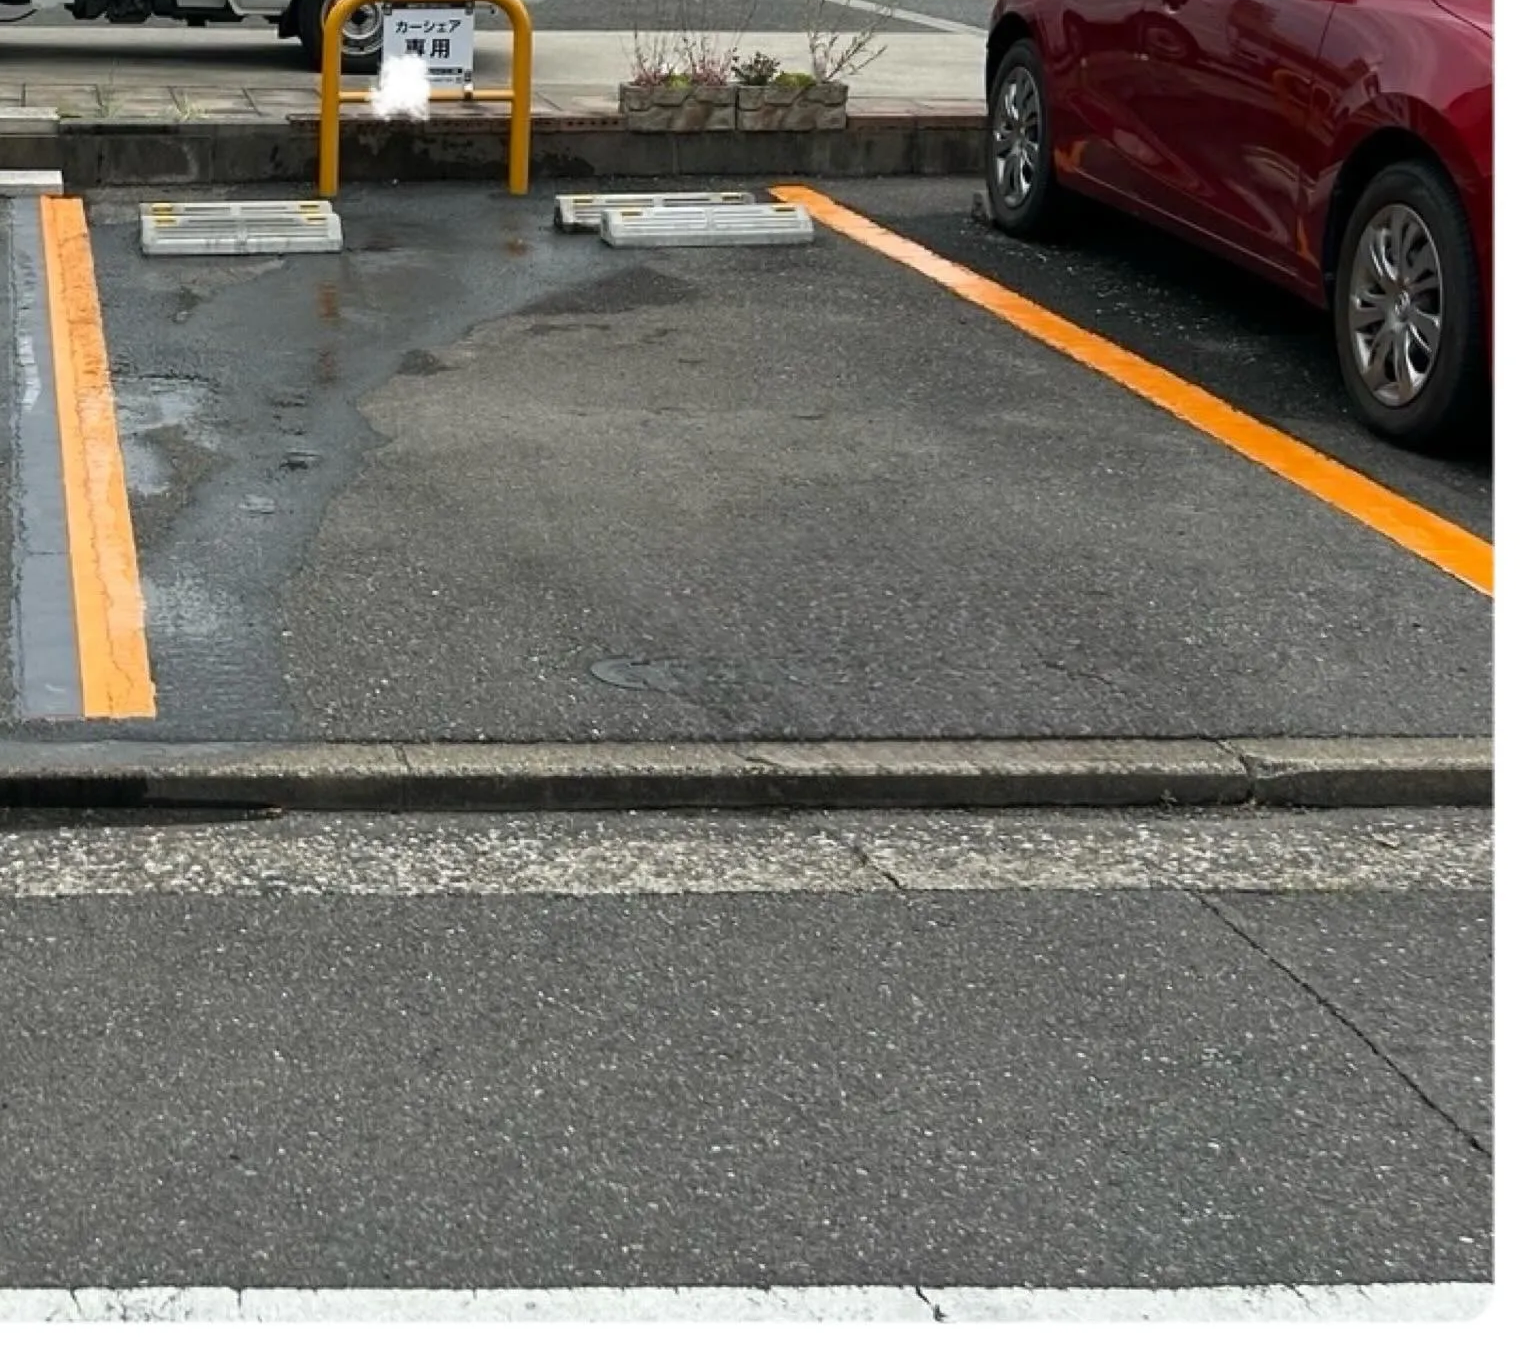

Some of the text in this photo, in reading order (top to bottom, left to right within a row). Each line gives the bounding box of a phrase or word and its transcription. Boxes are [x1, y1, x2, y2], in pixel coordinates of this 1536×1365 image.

[395, 19, 462, 34] カーシェア
